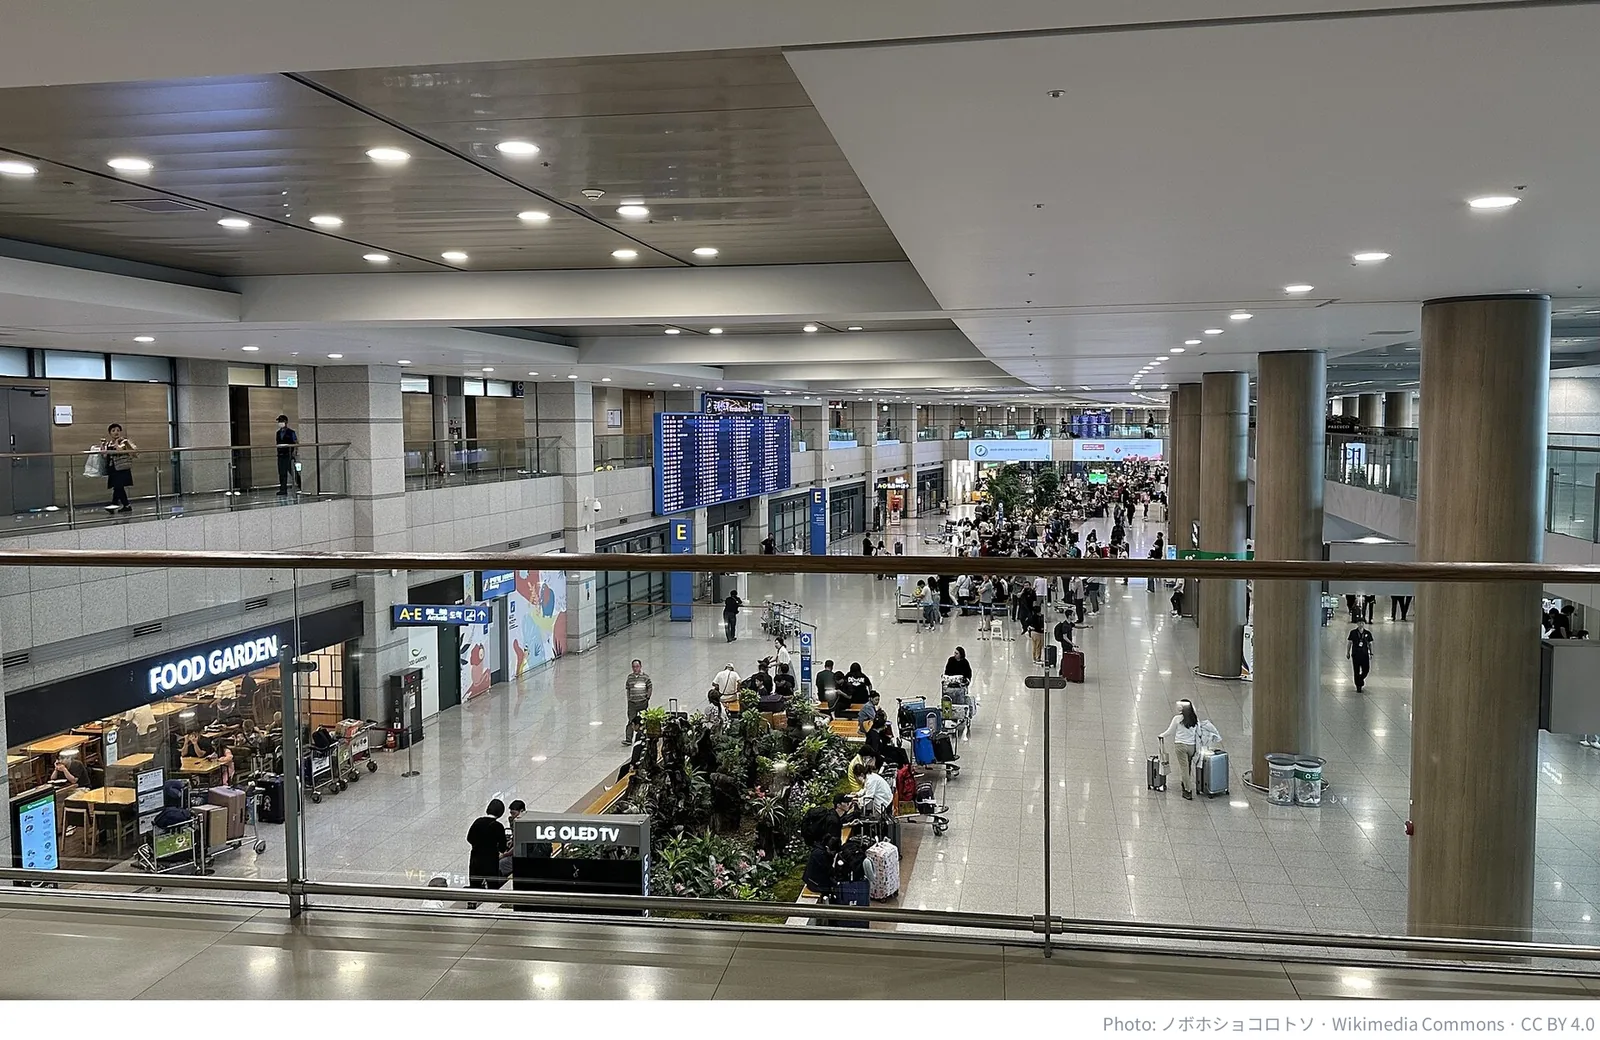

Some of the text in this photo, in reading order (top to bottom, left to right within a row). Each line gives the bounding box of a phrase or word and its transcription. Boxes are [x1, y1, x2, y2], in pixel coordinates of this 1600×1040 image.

[815, 491, 822, 503] E
[676, 524, 687, 540] E
[400, 608, 422, 621] A-E
[149, 635, 278, 694] FOOD GARDEN
[536, 826, 620, 842] LG OLED TV
